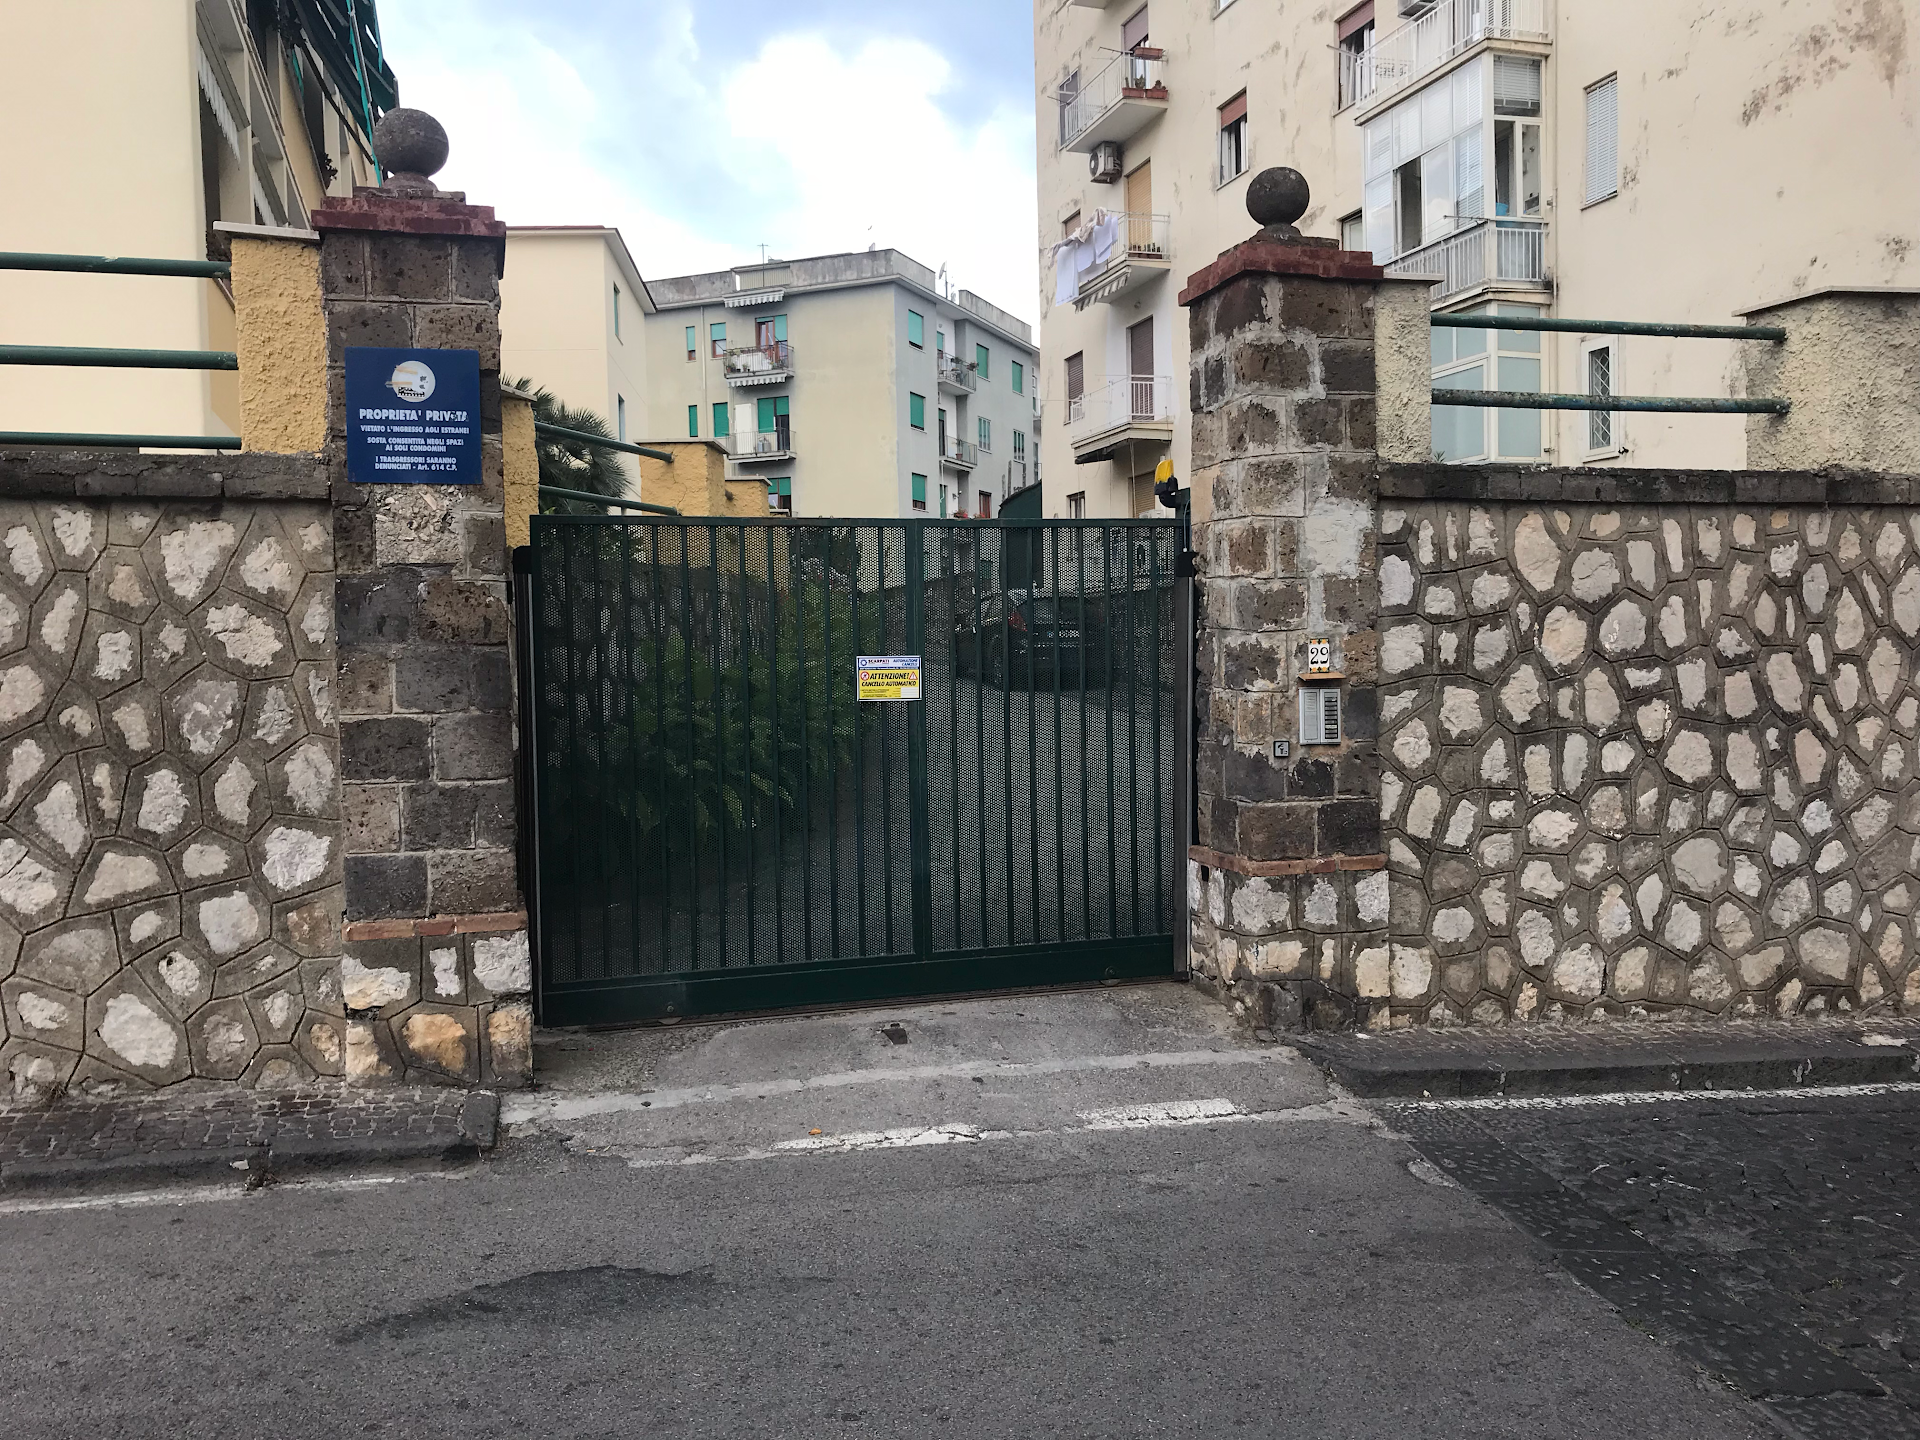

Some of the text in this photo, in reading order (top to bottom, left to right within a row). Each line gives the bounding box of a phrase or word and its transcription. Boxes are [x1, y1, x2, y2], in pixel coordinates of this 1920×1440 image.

[359, 409, 421, 420] PROPRIETA'
[388, 437, 426, 445] CONSENTITA
[1310, 646, 1329, 665] 29
